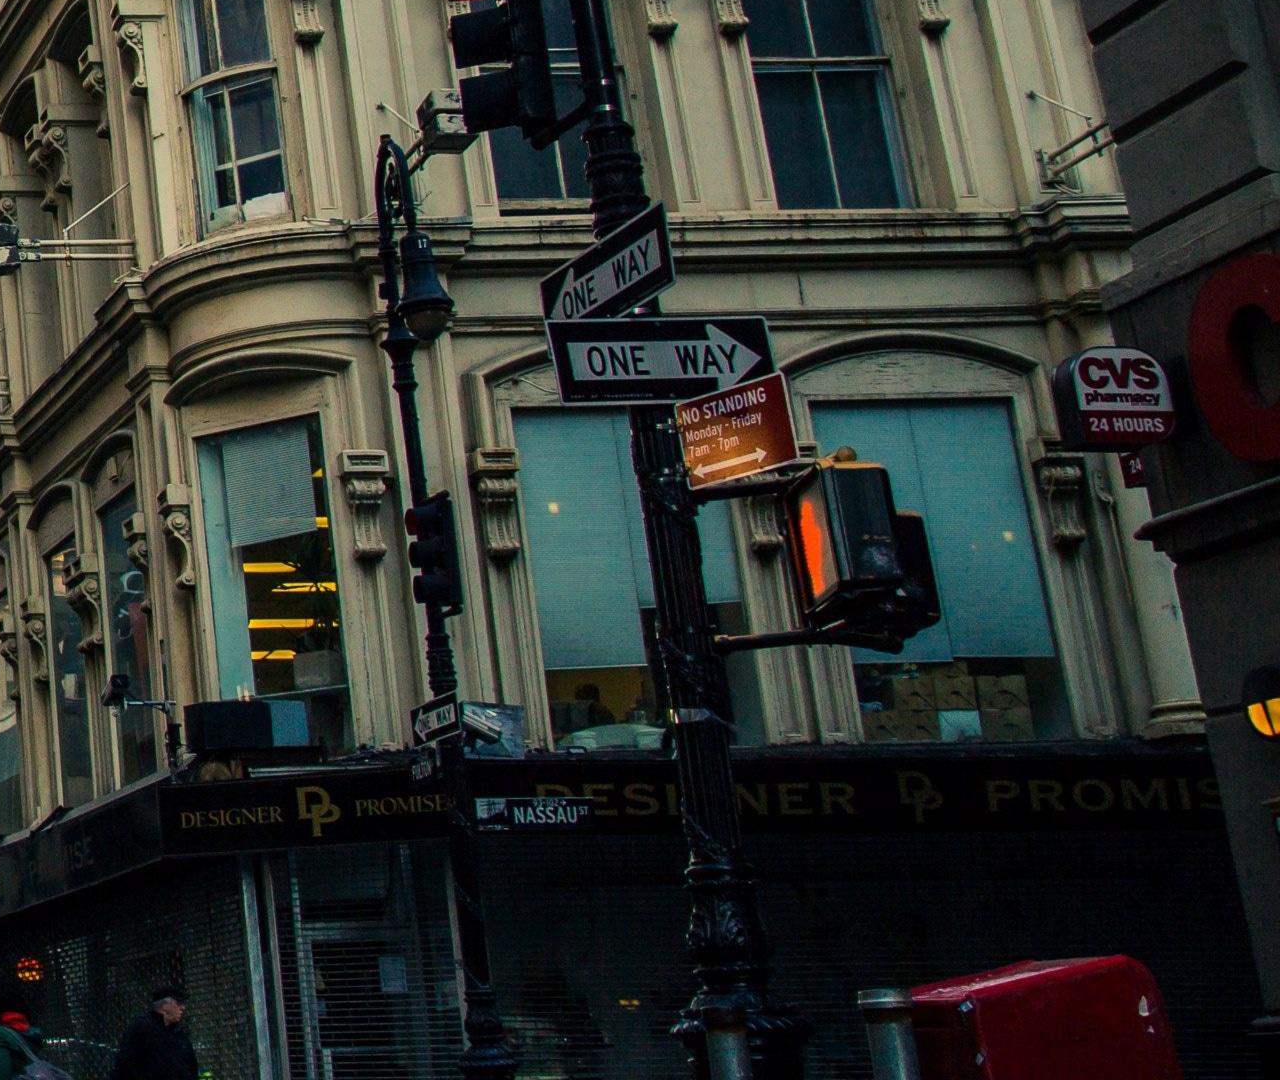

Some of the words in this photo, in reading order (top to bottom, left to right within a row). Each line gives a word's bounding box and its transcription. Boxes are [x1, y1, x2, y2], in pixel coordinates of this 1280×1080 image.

[562, 275, 598, 319] ONE
[612, 239, 650, 289] WAY
[587, 345, 650, 377] ONE
[674, 343, 738, 375] WAY
[1078, 357, 1159, 390] CVS
[682, 407, 699, 426] NO
[702, 387, 767, 419] STANDING
[1084, 391, 1160, 406] pharmacy
[685, 424, 722, 443] Monday
[731, 412, 762, 430] Friday
[1089, 418, 1109, 432] 24
[1114, 418, 1165, 433] HOURS
[688, 443, 710, 458] 7am
[717, 435, 740, 451] 7pm
[1128, 457, 1143, 475] 24
[434, 704, 454, 728] WAY
[178, 805, 284, 831] DESIGNER
[514, 806, 578, 824] NASSAU
[578, 806, 590, 815] ST
